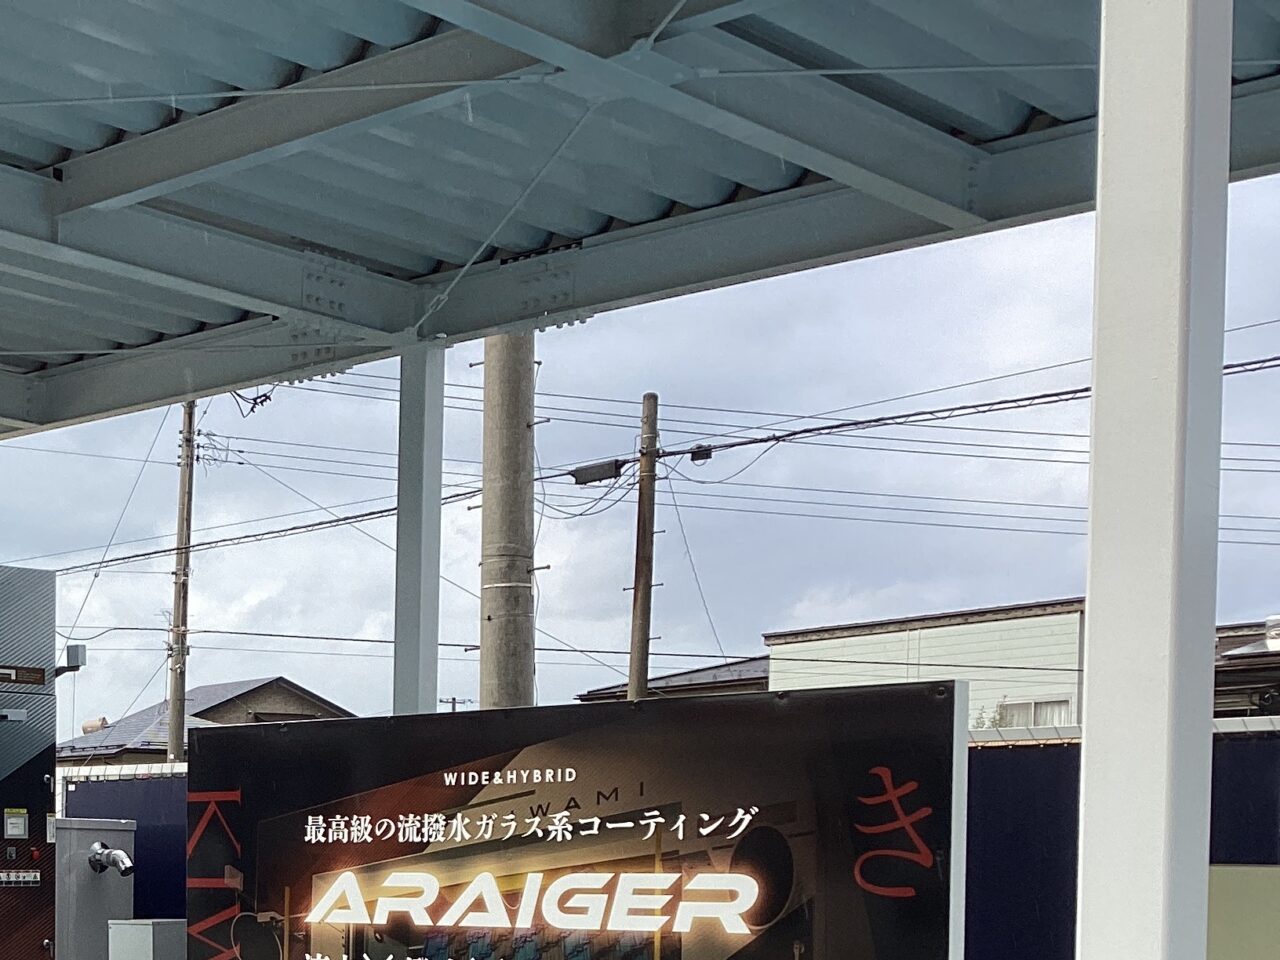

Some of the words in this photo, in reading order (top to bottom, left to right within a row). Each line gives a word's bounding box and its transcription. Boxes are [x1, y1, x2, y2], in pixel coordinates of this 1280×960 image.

[443, 767, 578, 787] WIDE&HYBRID
[303, 805, 760, 844] 最高級の流撥水ガラス系コーティング
[303, 871, 760, 935] ARAIGER
